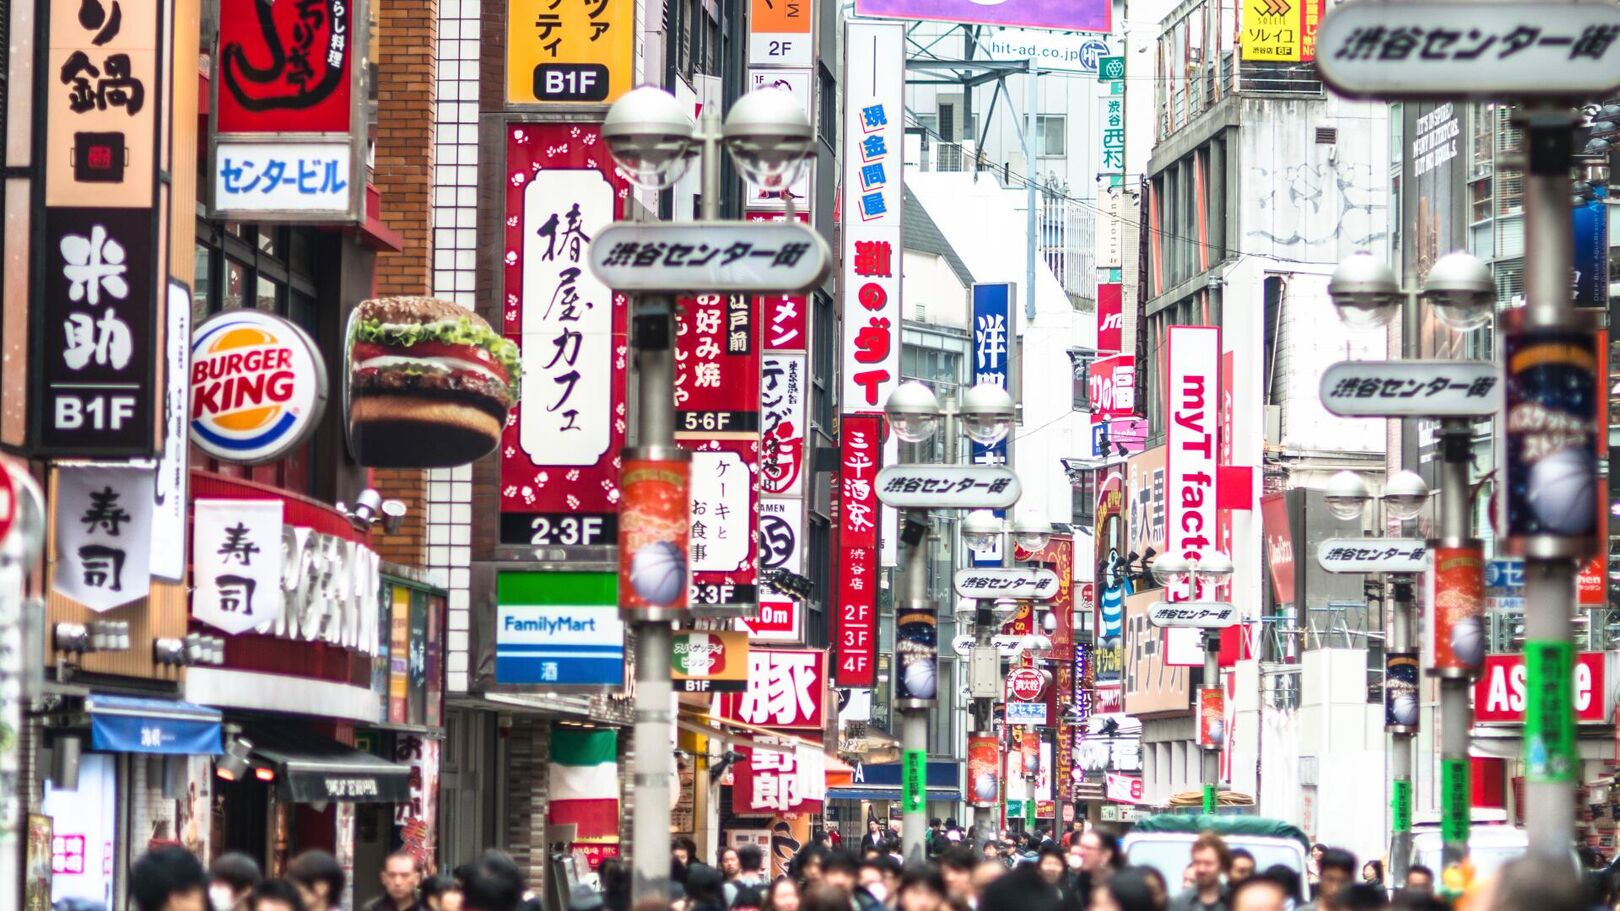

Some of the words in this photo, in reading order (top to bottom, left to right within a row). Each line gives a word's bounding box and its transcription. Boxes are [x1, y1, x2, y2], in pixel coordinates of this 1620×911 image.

[1249, 28, 1295, 43] ソレイユ
[1334, 24, 1620, 61] 渋谷センター街
[768, 41, 792, 56] 2F
[991, 41, 1078, 61] hit-ad.co.jp
[545, 70, 597, 94] B1F
[754, 74, 765, 84] 1F
[861, 104, 888, 216] 現金問屋
[220, 158, 347, 194] センタービル
[602, 242, 811, 268] 渋谷センター街
[59, 225, 132, 371] 米助
[536, 202, 594, 432] 椿屋カフェ
[191, 348, 293, 386] BURGER
[191, 371, 296, 420] KING
[1330, 377, 1497, 398] 渋谷センター街
[54, 396, 136, 430] B1F
[1174, 375, 1212, 460] myT
[883, 477, 1012, 494] 渋谷センター街
[713, 459, 732, 540] ケーキと
[761, 504, 785, 513] AMEN
[78, 486, 132, 592] 寿司
[690, 499, 708, 563] お食事
[1325, 548, 1426, 561] 渋谷センター街
[215, 521, 260, 616] 寿司
[849, 548, 865, 591] 渋谷店
[960, 577, 1053, 590] 渋谷センター街
[844, 605, 869, 621] 2F
[1156, 609, 1232, 620] 渋谷センター街
[504, 616, 596, 635] FamilyMart
[844, 631, 869, 647] 3F
[958, 640, 1020, 650] 渋谷ター街
[674, 643, 724, 656] スパゲッティ
[540, 662, 558, 681] 酒
[844, 656, 868, 672] 4F
[685, 680, 710, 692] B1F
[738, 651, 818, 725] 豚
[1015, 679, 1040, 691] 消火栓
